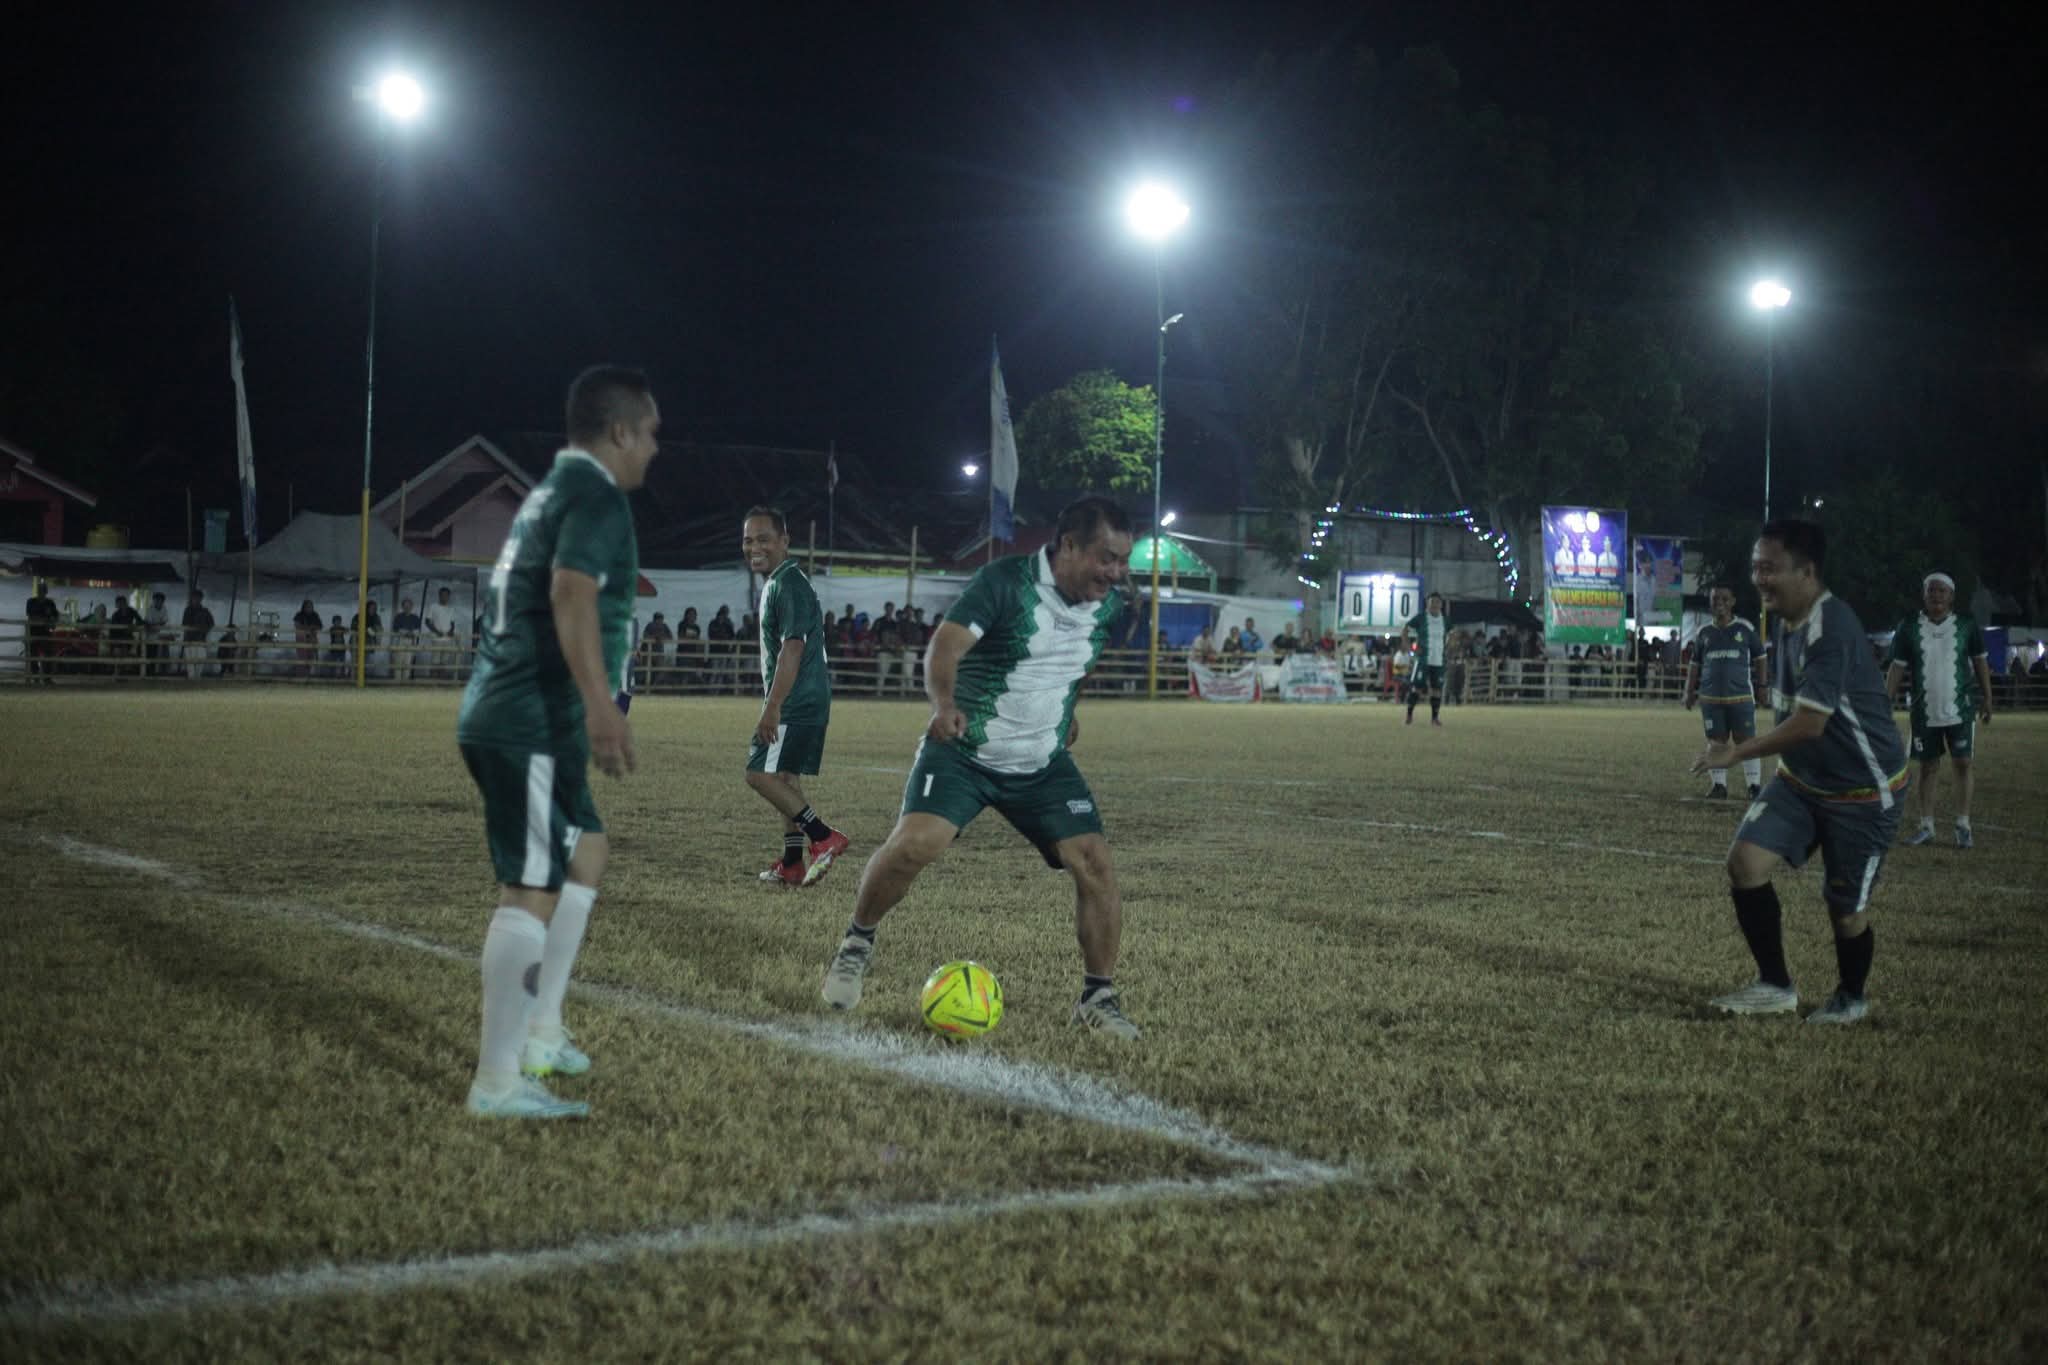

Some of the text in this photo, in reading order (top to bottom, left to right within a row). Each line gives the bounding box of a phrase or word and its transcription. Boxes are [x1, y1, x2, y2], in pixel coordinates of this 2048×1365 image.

[1353, 591, 1410, 617] 0 0
[923, 773, 934, 797] 1
